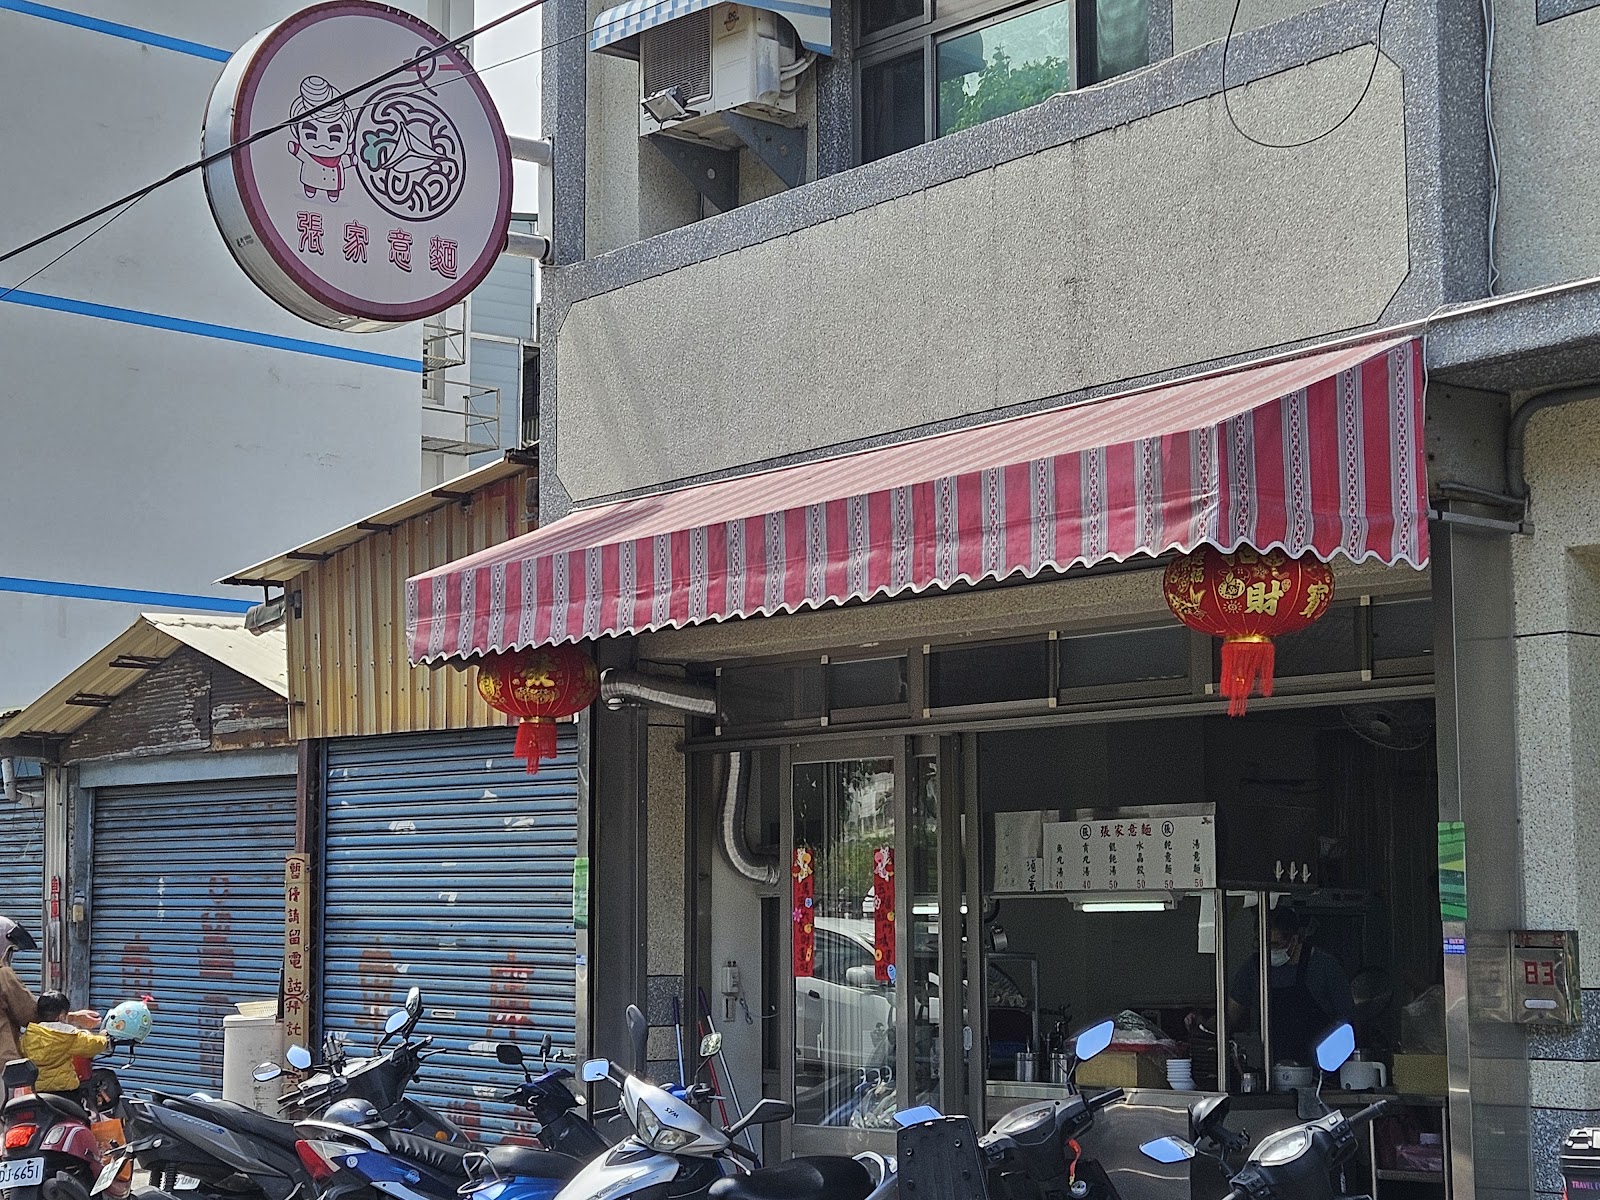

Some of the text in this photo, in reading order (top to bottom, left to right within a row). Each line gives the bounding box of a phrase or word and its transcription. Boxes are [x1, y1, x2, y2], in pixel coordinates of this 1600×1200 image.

[297, 211, 458, 280] 張家意麵
[1244, 580, 1284, 616] 財
[1100, 823, 1152, 837] 張家意麵
[1055, 880, 1063, 889] 40
[1083, 880, 1091, 889] 40
[1109, 880, 1118, 889] 50
[1136, 880, 1146, 889] 50
[1164, 880, 1173, 888] 50
[1194, 879, 1204, 887] 50
[1524, 961, 1555, 985] 83
[664, 1107, 679, 1119] SYM
[1571, 1180, 1593, 1190] TRAVEL
